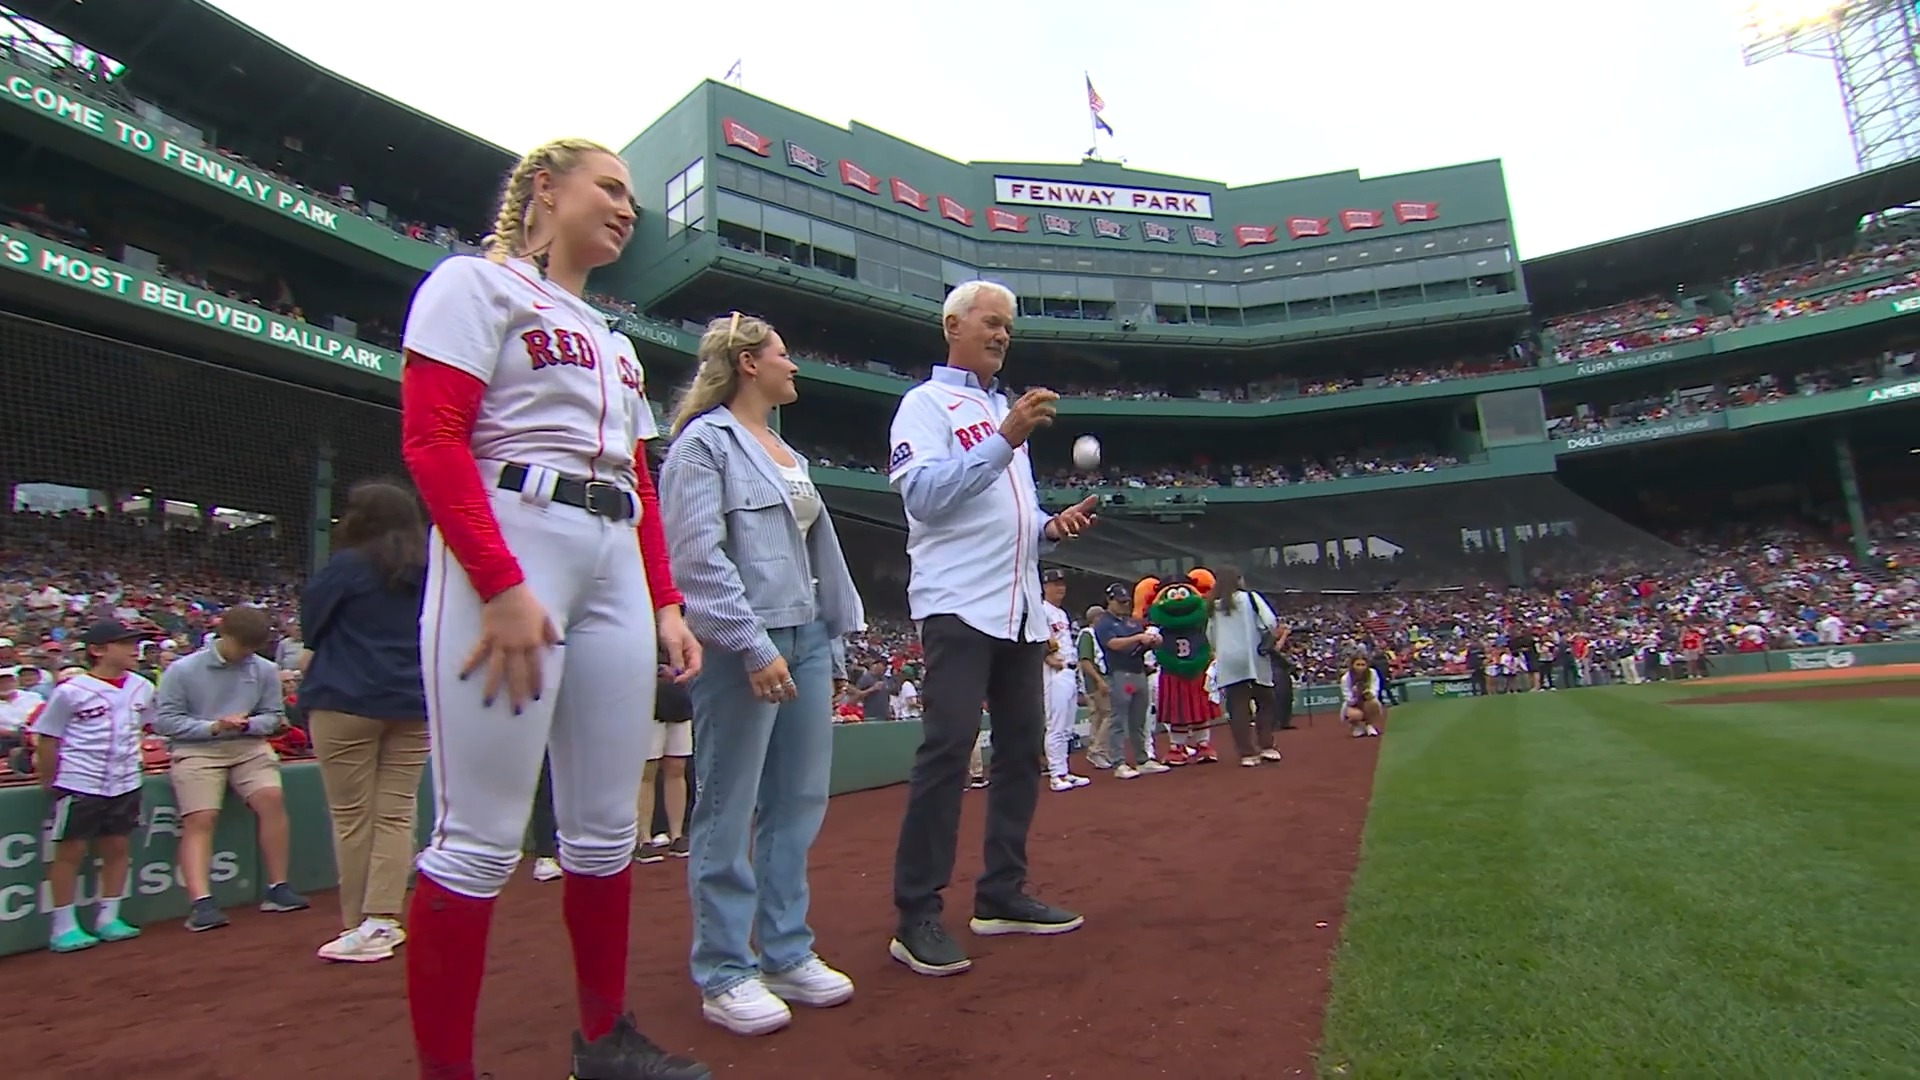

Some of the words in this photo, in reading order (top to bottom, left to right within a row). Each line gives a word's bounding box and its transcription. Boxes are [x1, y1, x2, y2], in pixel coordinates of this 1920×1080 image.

[115, 120, 154, 151] TO
[162, 140, 272, 201] FENWAY
[277, 190, 338, 230] PARK
[1011, 184, 1115, 205] FENWAY
[1132, 193, 1198, 213] PARK
[40, 249, 133, 294] MOST
[141, 280, 264, 334] BELOVED
[269, 321, 383, 371] BALLPARK
[625, 320, 678, 346] PAVILION
[521, 328, 595, 371] RED
[1617, 350, 1673, 367] PAVILION
[1568, 435, 1602, 449] DELL
[1601, 424, 1675, 443] Technologies
[1676, 419, 1709, 432] Level
[1176, 638, 1191, 658] B
